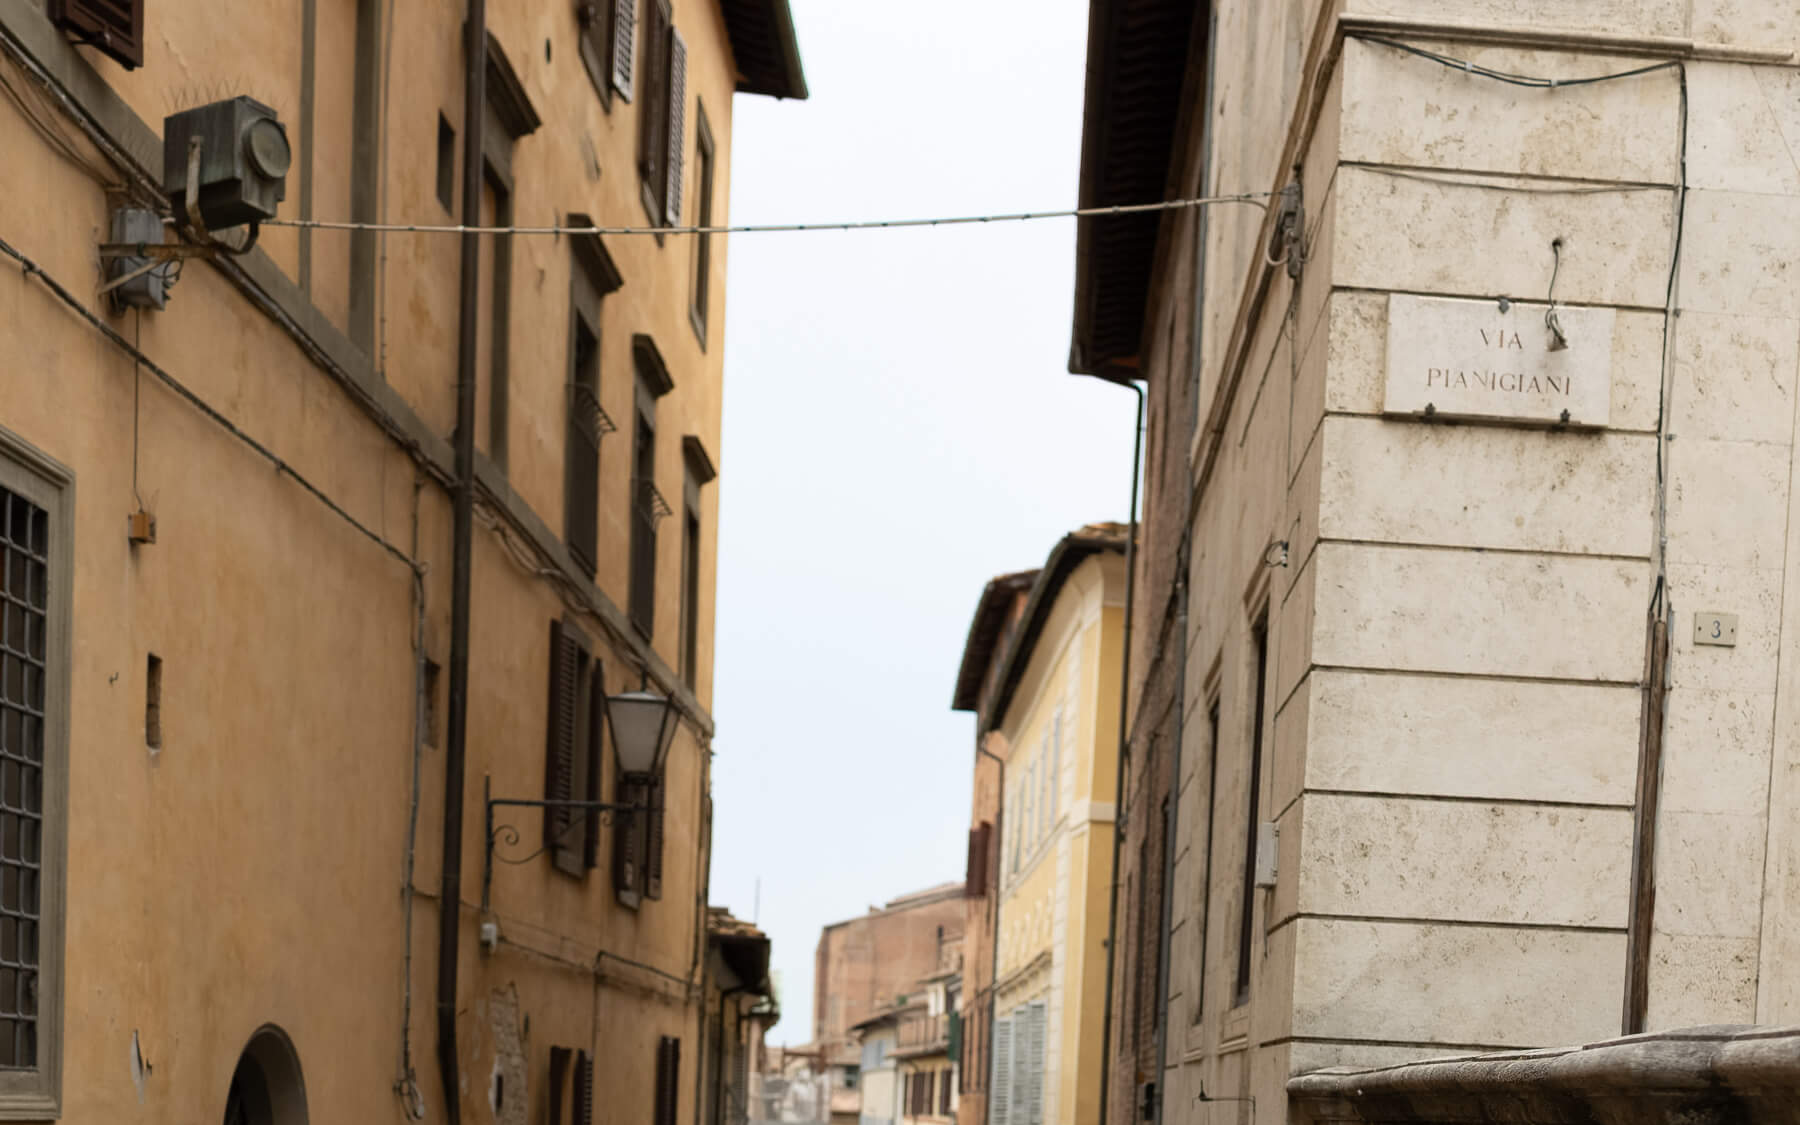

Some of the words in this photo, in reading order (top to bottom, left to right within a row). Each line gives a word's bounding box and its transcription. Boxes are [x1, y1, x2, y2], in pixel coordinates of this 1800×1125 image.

[1480, 328, 1523, 350] VIA
[1426, 367, 1571, 396] PIANIGIANI
[1711, 620, 1721, 639] 3
